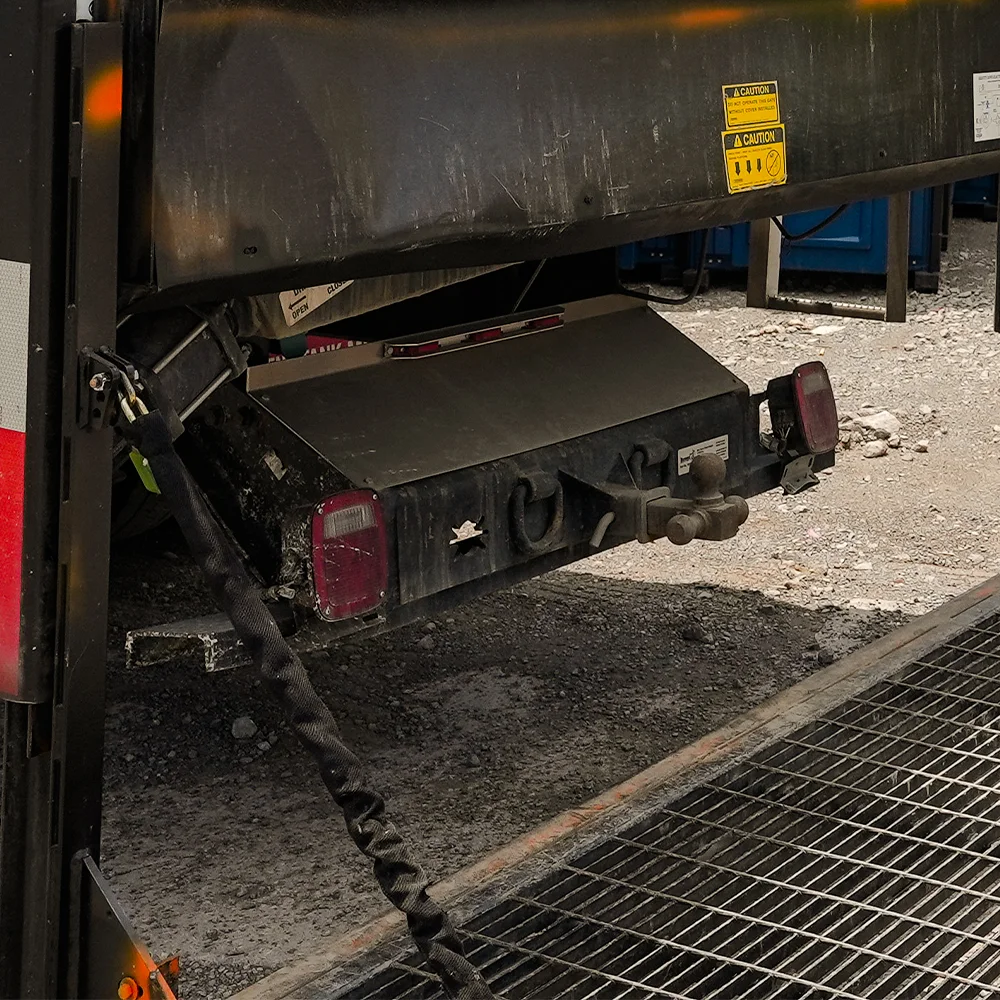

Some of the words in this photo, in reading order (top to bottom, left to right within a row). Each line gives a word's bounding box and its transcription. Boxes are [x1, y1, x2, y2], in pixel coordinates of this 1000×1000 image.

[740, 86, 769, 95] CAUTION
[743, 131, 775, 145] CAUTION
[292, 303, 309, 319] OPEN
